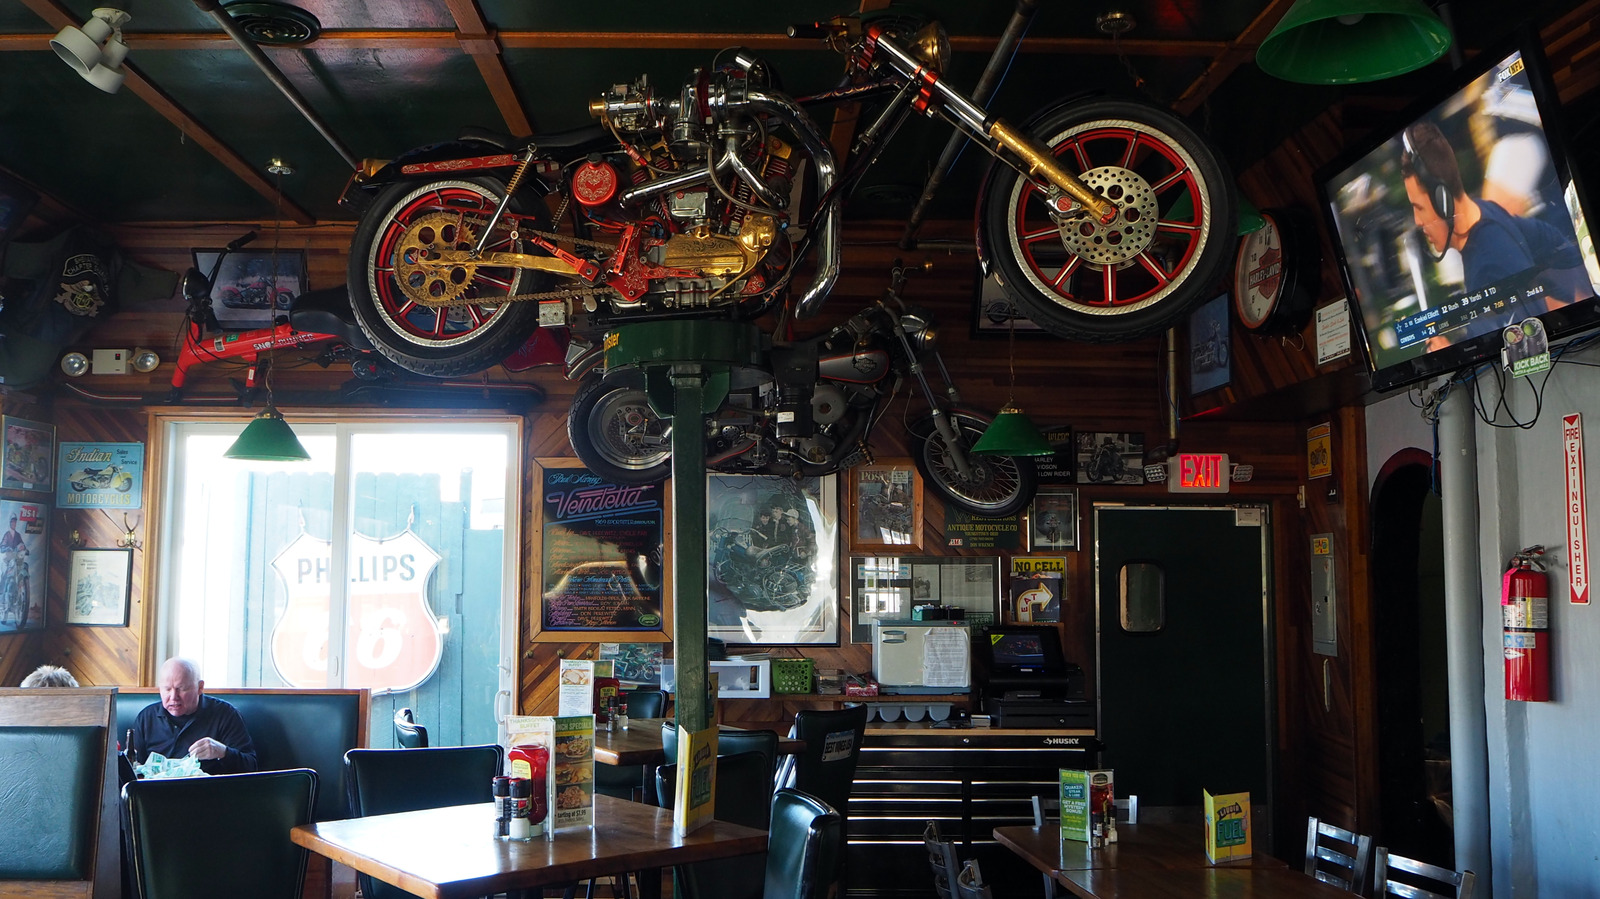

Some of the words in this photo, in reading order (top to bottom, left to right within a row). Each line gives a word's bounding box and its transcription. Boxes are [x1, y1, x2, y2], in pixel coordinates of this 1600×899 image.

[1498, 67, 1511, 82] FOX
[1510, 60, 1523, 75] NFL
[1250, 262, 1281, 286] HARLEY-DAVID
[1441, 304, 1448, 314] 12
[1448, 302, 1459, 311] Rush
[1461, 296, 1469, 306] 39
[1469, 292, 1482, 303] Yards
[1484, 289, 1489, 297] 1
[1489, 286, 1497, 295] TD
[1427, 325, 1436, 335] 24
[1469, 310, 1478, 320] 21
[1483, 305, 1491, 313] 3rd
[1509, 295, 1517, 304] 25
[1526, 289, 1536, 298] 2nd
[1514, 359, 1529, 371] KICK
[1530, 353, 1548, 367] BACK
[1565, 427, 1579, 440] FIRE
[66, 446, 113, 464] Indian
[1180, 454, 1223, 488] EXIT
[67, 493, 131, 505] MOTORCYCLES
[546, 484, 656, 519] Vendetta
[1569, 442, 1582, 587] EXTINGUISHER
[947, 523, 975, 532] ANTIQUE
[975, 523, 1008, 532] MOTOCYCLE
[1009, 523, 1018, 532] CO
[297, 553, 416, 584] PHLIPS
[1014, 561, 1031, 571] NO
[1034, 561, 1063, 571] CELL
[1021, 593, 1037, 613] EAT
[569, 721, 592, 730] SPECIALS
[825, 741, 835, 753] BEST
[1217, 820, 1245, 841] FUEL
